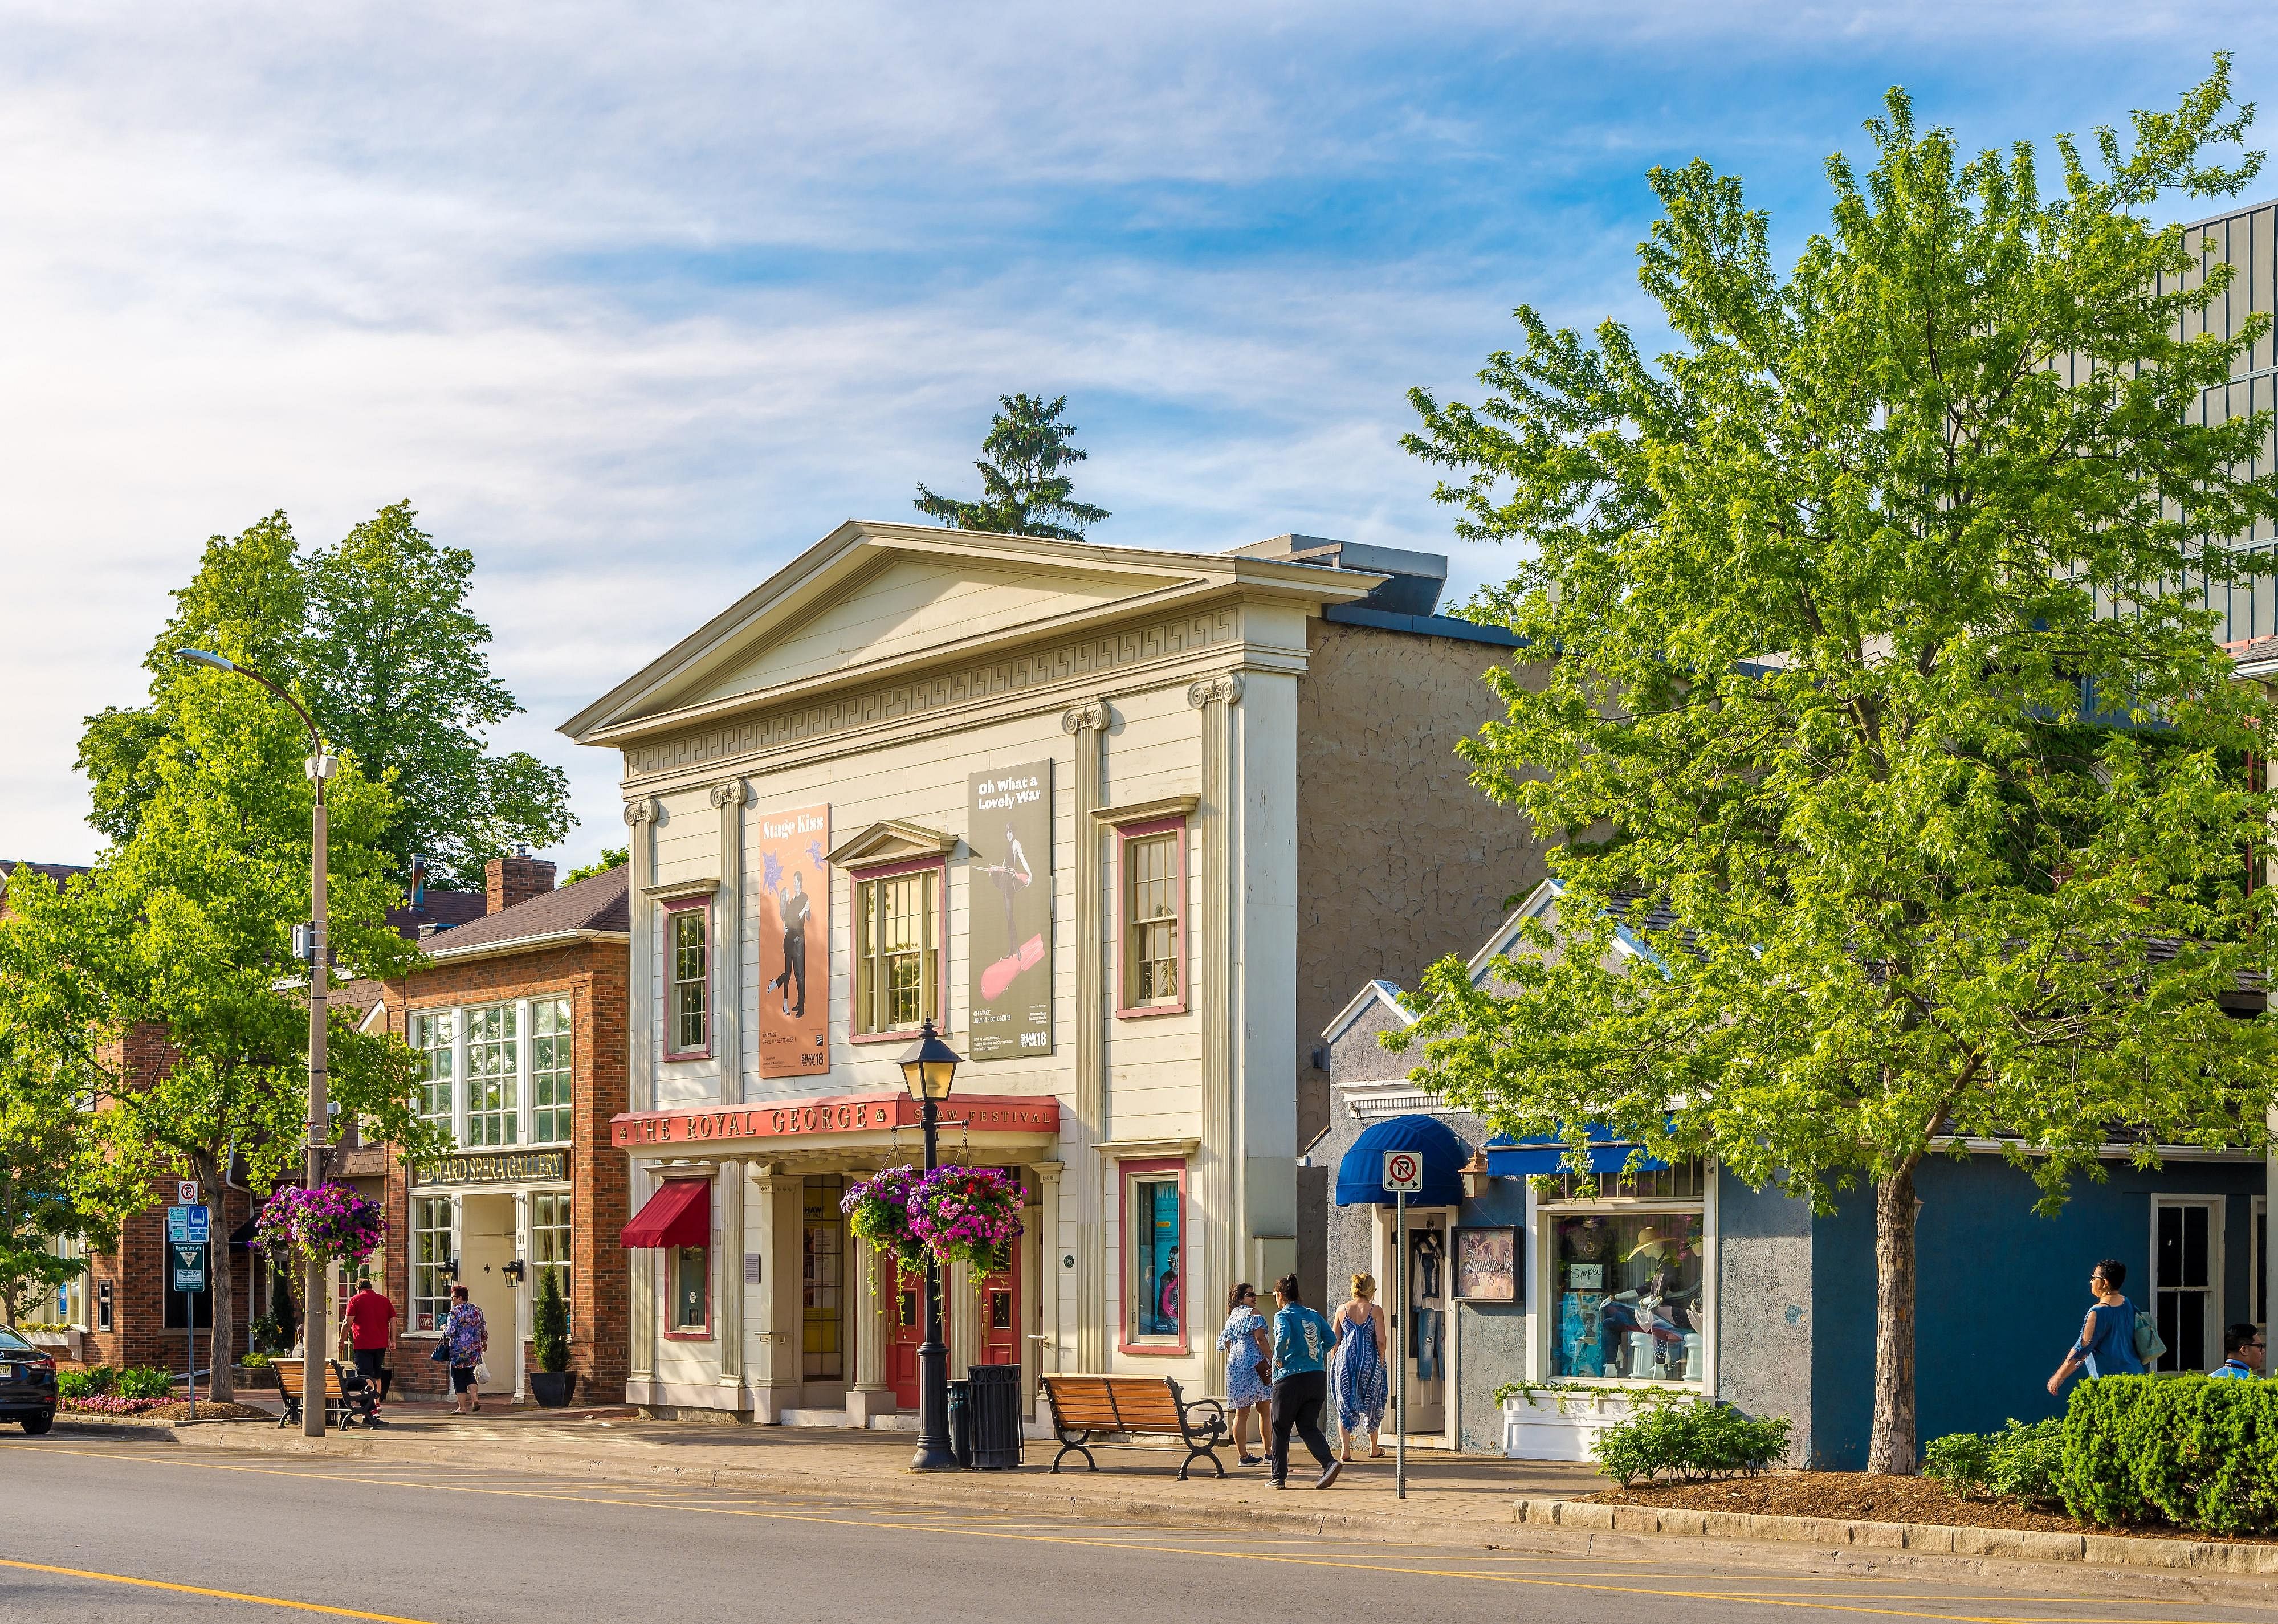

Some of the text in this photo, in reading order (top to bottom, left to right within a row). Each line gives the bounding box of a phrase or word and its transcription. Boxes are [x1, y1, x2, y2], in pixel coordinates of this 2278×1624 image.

[978, 777, 1038, 795] Oh What a
[978, 790, 1041, 810] Lovely War
[763, 814, 824, 839] Stage Kiss
[1020, 1031, 1046, 1046] SHAW 18
[801, 1052, 824, 1066] SHAW 18
[633, 1104, 867, 1142] THE ROYAL GEORGE
[914, 1109, 1052, 1123] SAW FESTIVAL
[418, 1153, 563, 1184] EDWARD SPERA GALLERY
[517, 1234, 524, 1244] 91
[1464, 1248, 1499, 1276] Frankie
[1571, 1265, 1603, 1280] Sympli
[419, 1317, 433, 1327] OPEN
